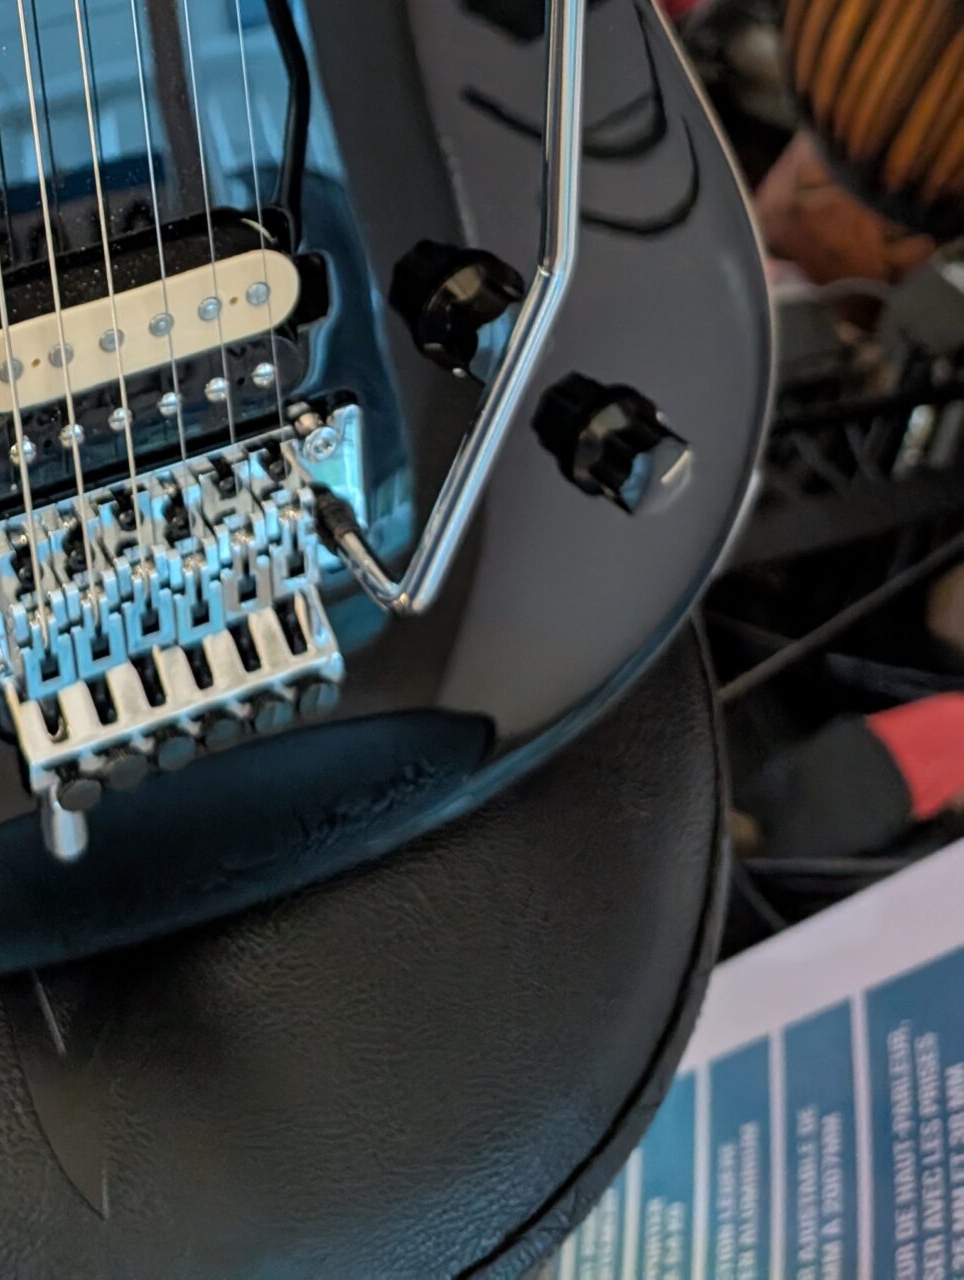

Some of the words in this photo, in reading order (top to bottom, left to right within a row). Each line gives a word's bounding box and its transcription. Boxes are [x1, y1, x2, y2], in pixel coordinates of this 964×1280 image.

[914, 1031, 941, 1118] PRISES
[918, 1118, 944, 1167] LES
[895, 1204, 918, 1241] DE
[921, 1167, 945, 1230] AVEC
